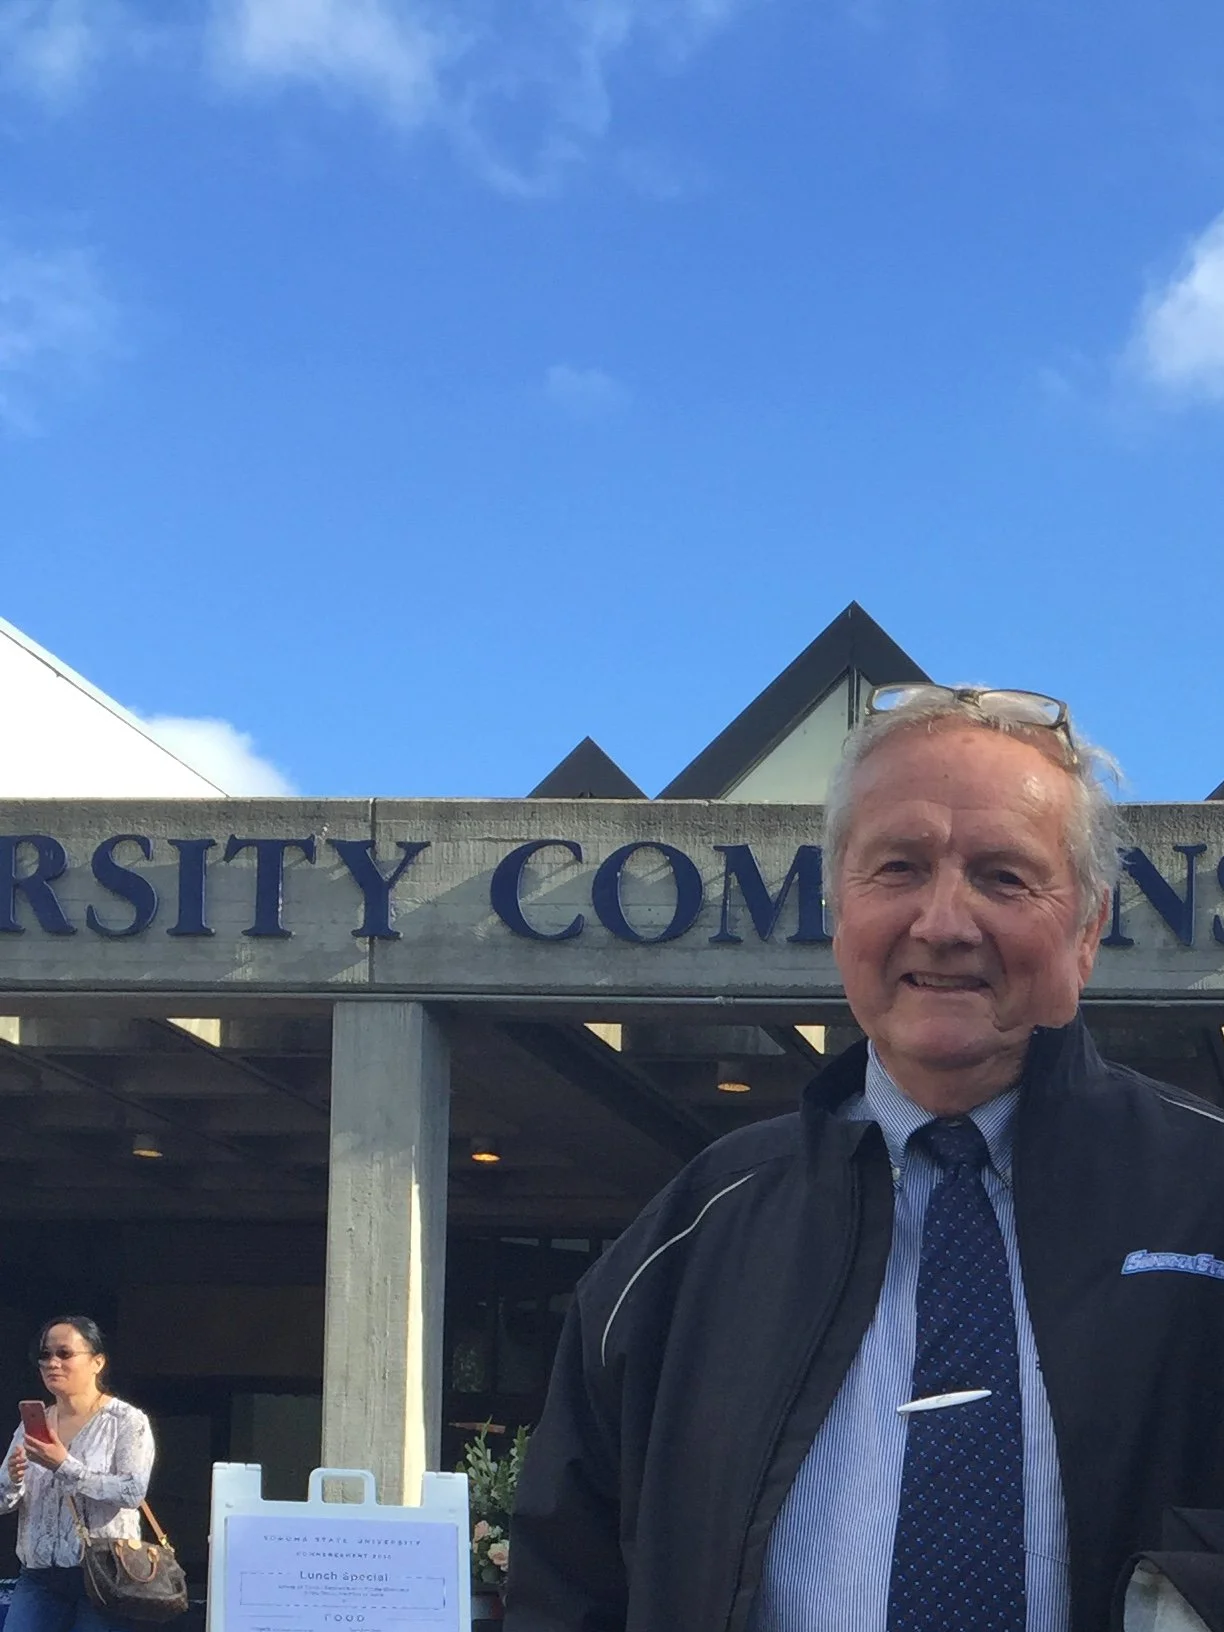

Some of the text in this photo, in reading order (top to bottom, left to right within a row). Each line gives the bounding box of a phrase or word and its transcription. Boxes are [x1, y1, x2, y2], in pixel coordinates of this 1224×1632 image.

[0, 833, 432, 940] RSITY
[314, 1536, 349, 1544] STATE
[357, 1538, 421, 1546] UNIVERSITY
[300, 1570, 389, 1583] Lunch Special
[324, 1613, 366, 1622] FOOD
